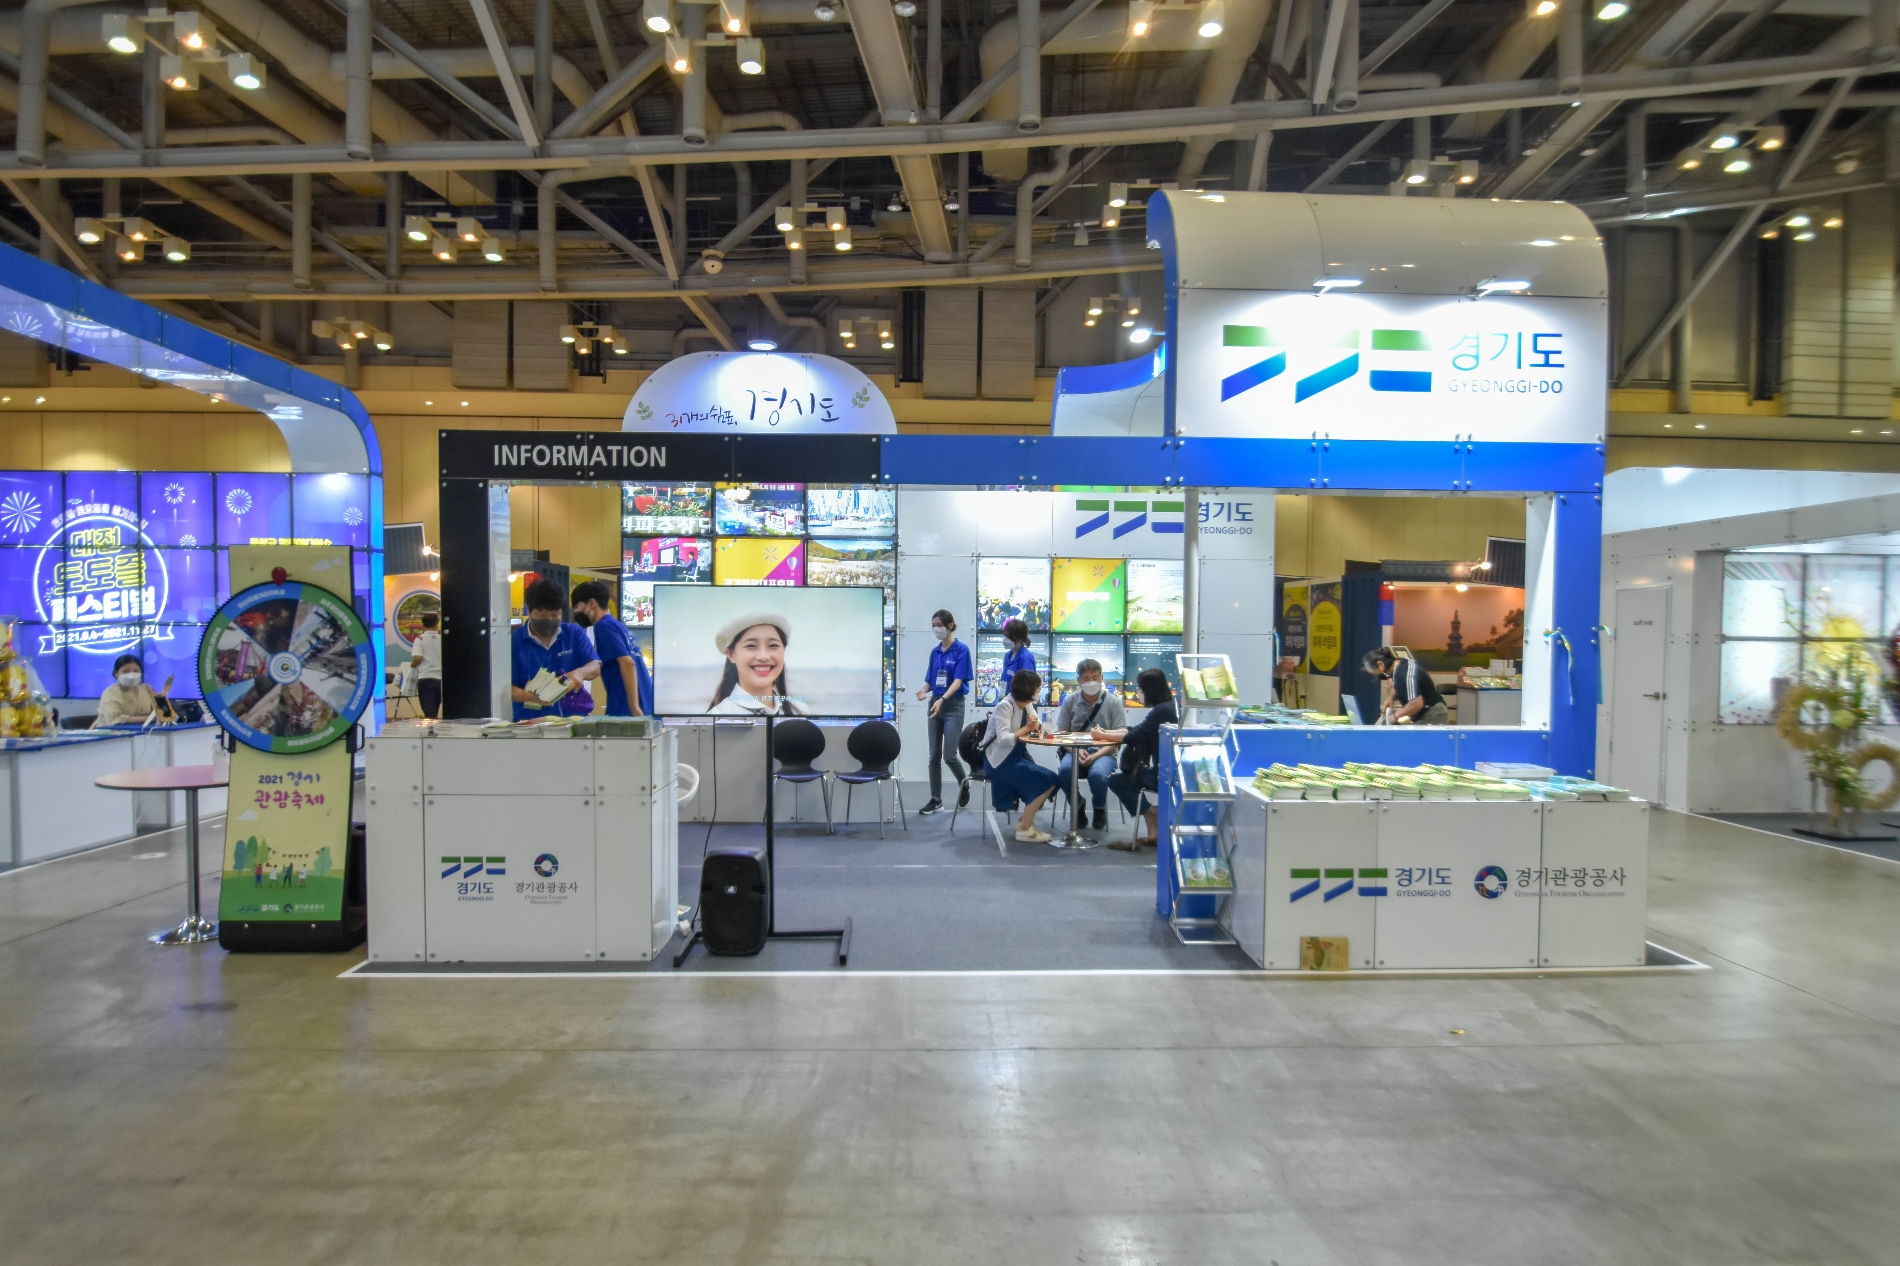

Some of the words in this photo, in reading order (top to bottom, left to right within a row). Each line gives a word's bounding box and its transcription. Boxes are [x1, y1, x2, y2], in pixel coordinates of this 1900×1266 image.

[1446, 331, 1565, 371] 경기도
[1448, 378, 1563, 394] GYEONGGI-DO
[493, 444, 667, 467] INFORMATION
[1198, 526, 1253, 535] YEONGGI-DO
[70, 525, 121, 558] 대전
[54, 552, 147, 596] 토토즐
[51, 586, 156, 622] 페스티벌
[258, 774, 283, 784] 2021
[286, 770, 321, 787] 경기
[253, 789, 325, 809] 관광축제
[514, 881, 579, 893] 경기관광공사
[1394, 867, 1453, 887] 경기도
[1514, 867, 1627, 888] 경기관광공사
[456, 881, 495, 895] 경기도
[1396, 889, 1451, 897] GYEONGGI-DO
